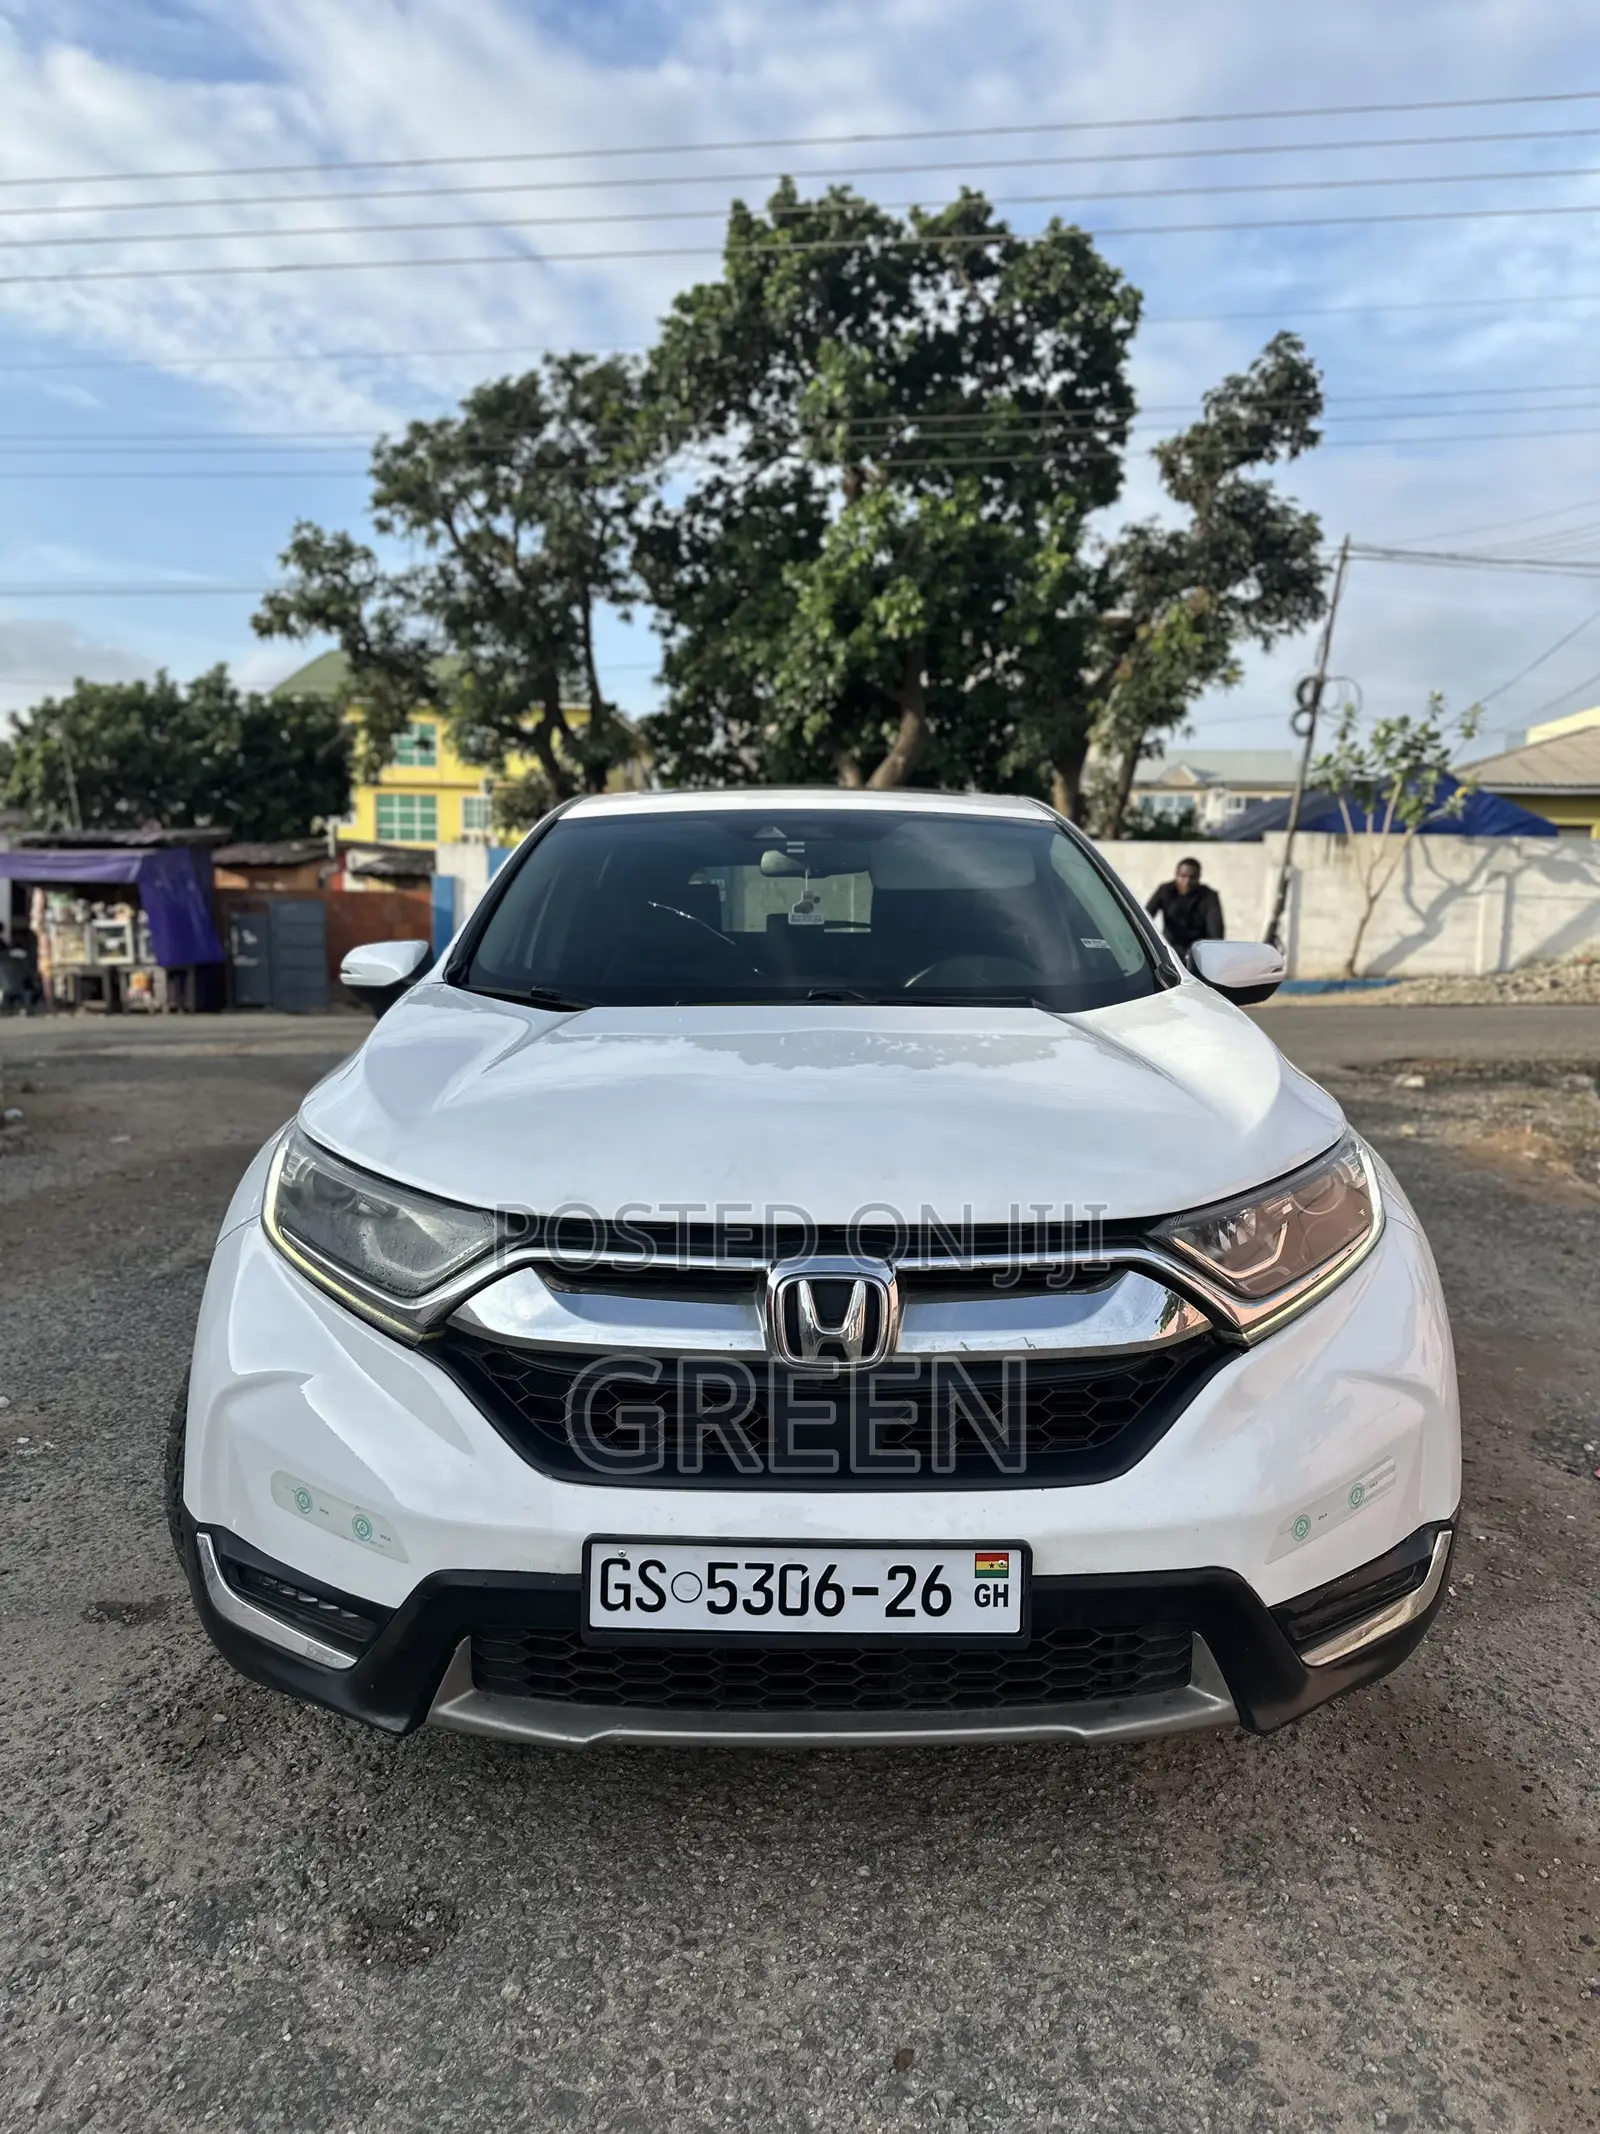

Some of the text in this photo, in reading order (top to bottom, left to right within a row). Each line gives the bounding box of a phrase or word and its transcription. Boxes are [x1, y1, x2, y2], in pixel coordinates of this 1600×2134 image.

[600, 1557, 952, 1618] GS 5306-26
[973, 1583, 1010, 1609] GH
